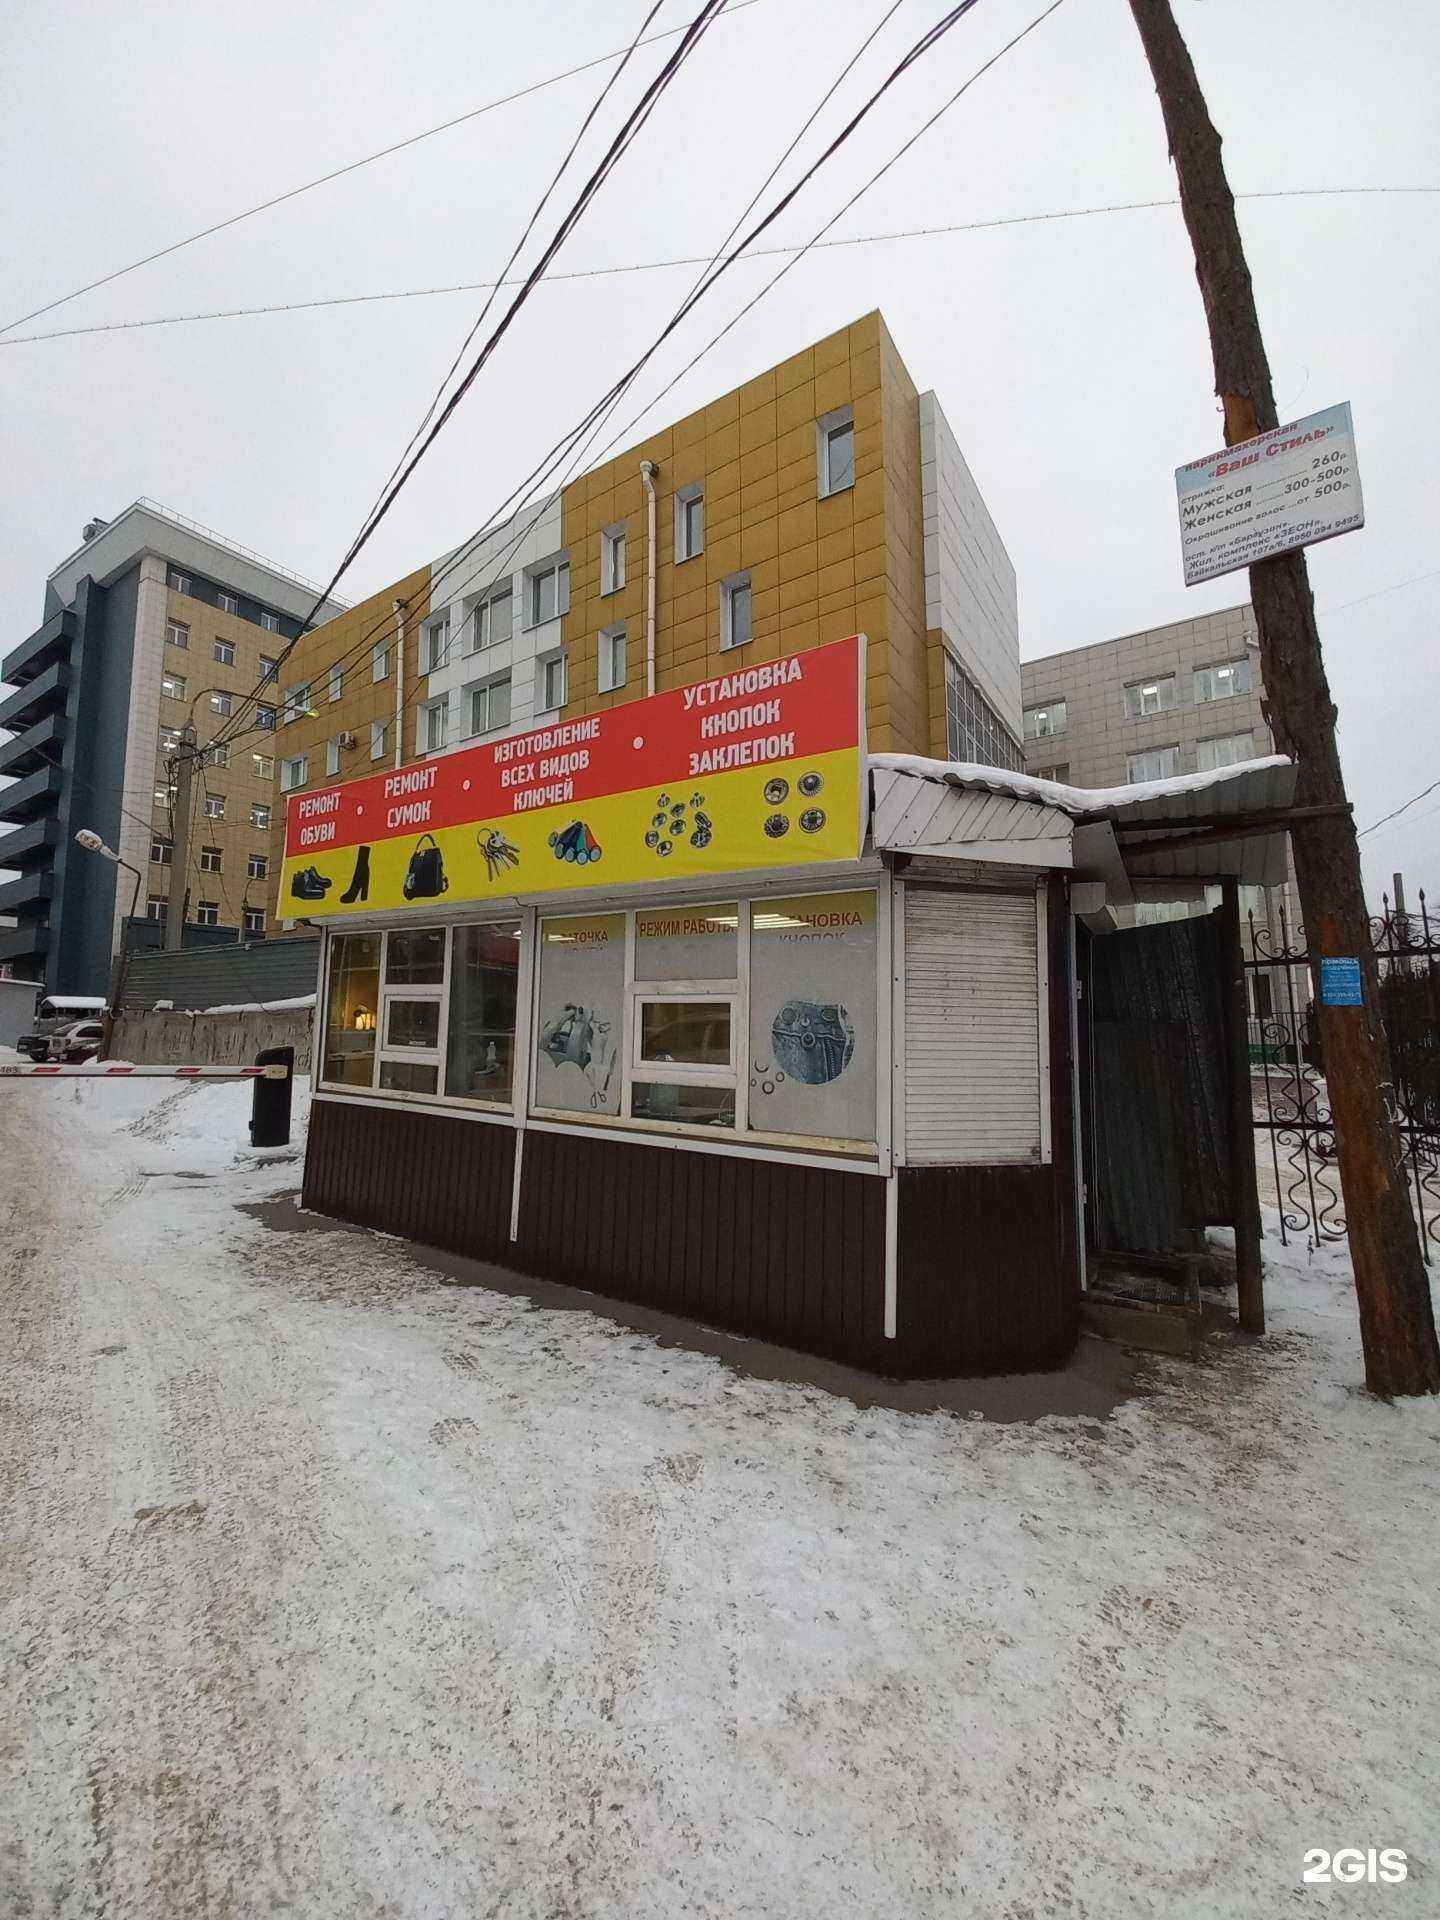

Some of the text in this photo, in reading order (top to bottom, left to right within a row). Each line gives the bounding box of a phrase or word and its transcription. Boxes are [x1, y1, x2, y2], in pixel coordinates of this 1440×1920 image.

[1182, 485, 1252, 517] Мужская
[1183, 500, 1252, 531] Женская
[683, 657, 802, 711] УСТАНОВКА
[701, 698, 781, 739] КНОПОК
[494, 717, 601, 764] ИЗГОТОВЛЕНИЕ
[689, 731, 795, 776] ЗАКЛЕПОК
[384, 766, 438, 799] РЕМОНТ
[501, 749, 590, 788] ВСЕХ ВИДОВ
[299, 792, 341, 819] РЕМОНТ
[513, 777, 574, 811] КЛЮЧЕЙ
[386, 800, 432, 829] СУМОК
[300, 822, 335, 846] ОБУВИ
[639, 920, 680, 938] РЕЖИМ
